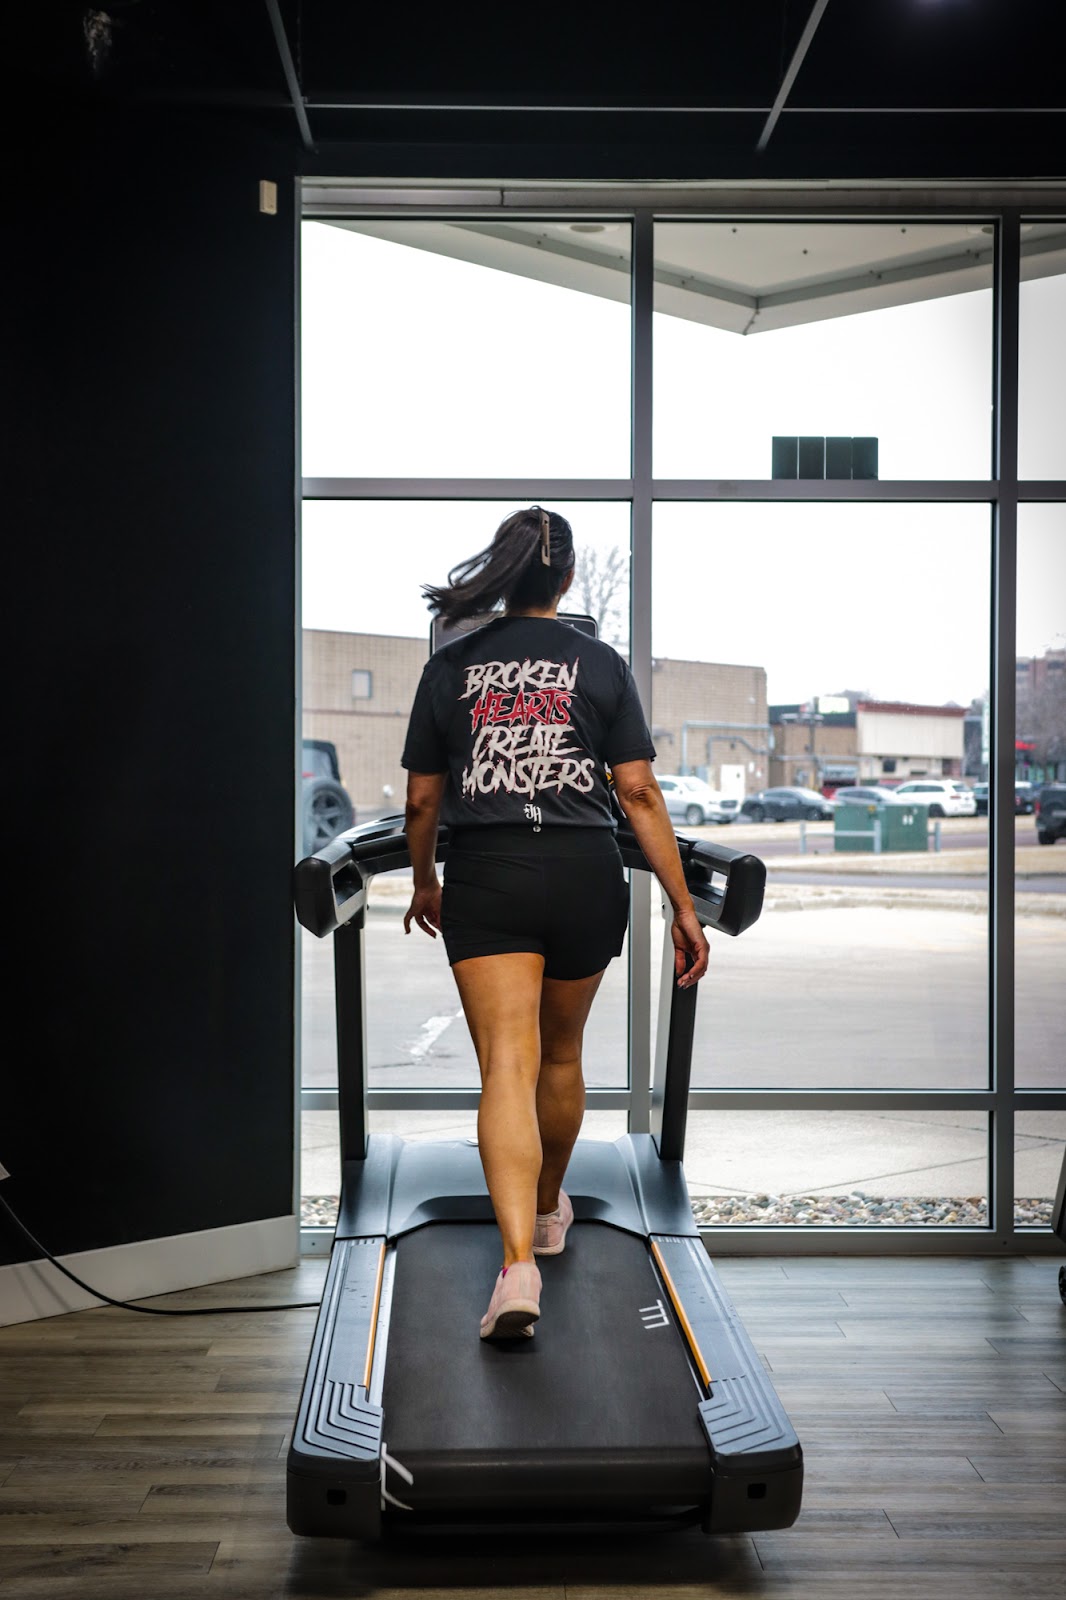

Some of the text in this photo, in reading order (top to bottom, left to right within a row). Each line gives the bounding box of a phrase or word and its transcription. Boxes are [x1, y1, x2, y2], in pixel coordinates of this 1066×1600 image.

[458, 657, 579, 700] BROKEN
[470, 689, 577, 732] HEARTS
[472, 722, 583, 760] CREATE
[462, 756, 595, 801] MONSTERS
